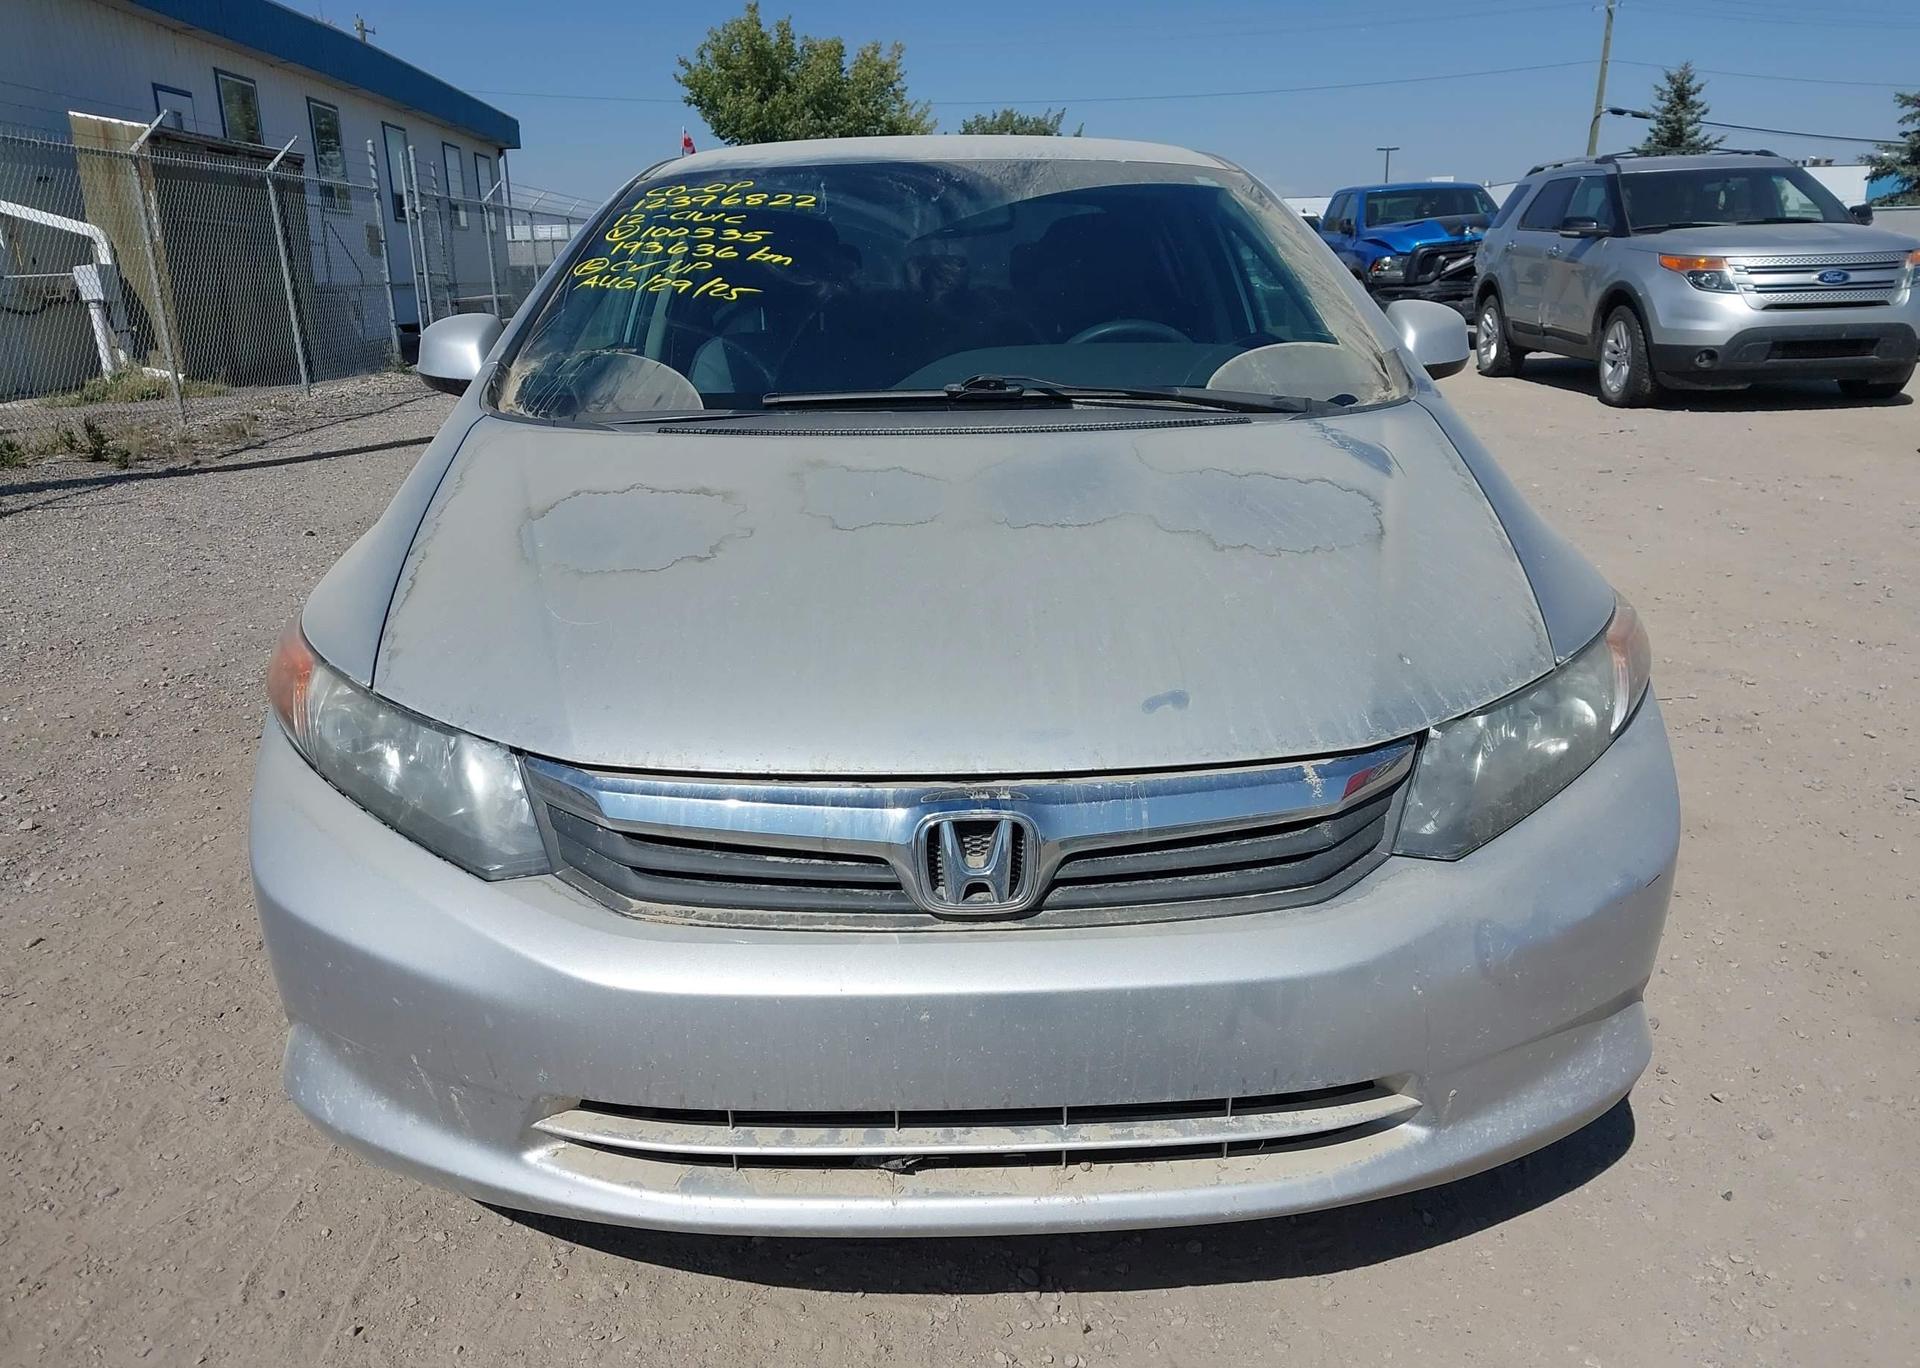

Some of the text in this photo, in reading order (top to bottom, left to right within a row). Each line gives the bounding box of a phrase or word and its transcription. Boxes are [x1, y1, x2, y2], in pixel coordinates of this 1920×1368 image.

[647, 181, 754, 198] CO-OP
[631, 193, 817, 211] 12396822
[611, 241, 793, 266] 193636 km
